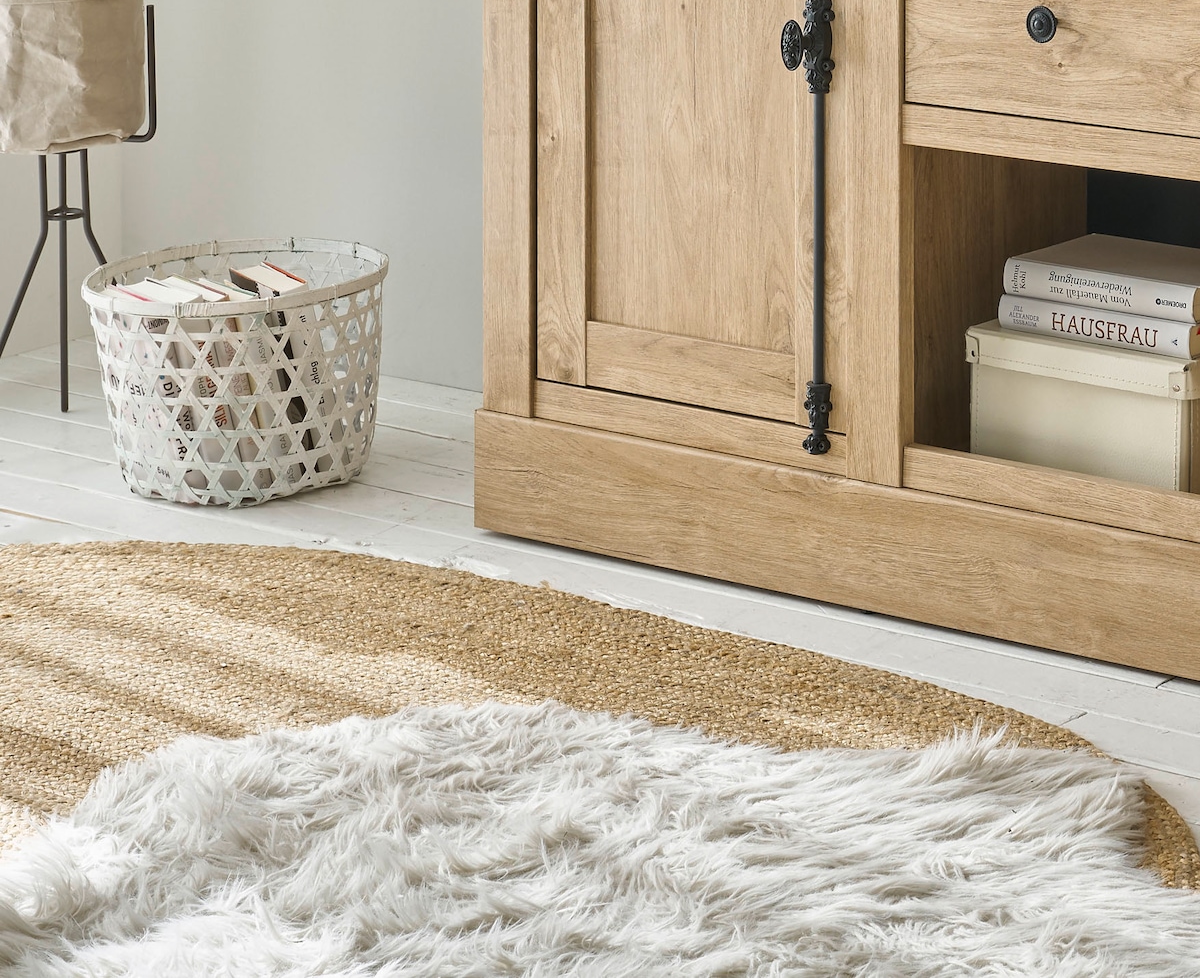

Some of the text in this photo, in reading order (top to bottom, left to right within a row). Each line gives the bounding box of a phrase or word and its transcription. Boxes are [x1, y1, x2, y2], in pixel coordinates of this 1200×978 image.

[1011, 264, 1021, 293] Helmut
[1048, 270, 1132, 296] Wiedervereinigung
[1049, 286, 1132, 307] Vom Mauerfall zur
[1161, 299, 1187, 309] DROEMER
[1009, 311, 1040, 322] ALEXANDER
[1051, 312, 1159, 348] HAUSFRAU
